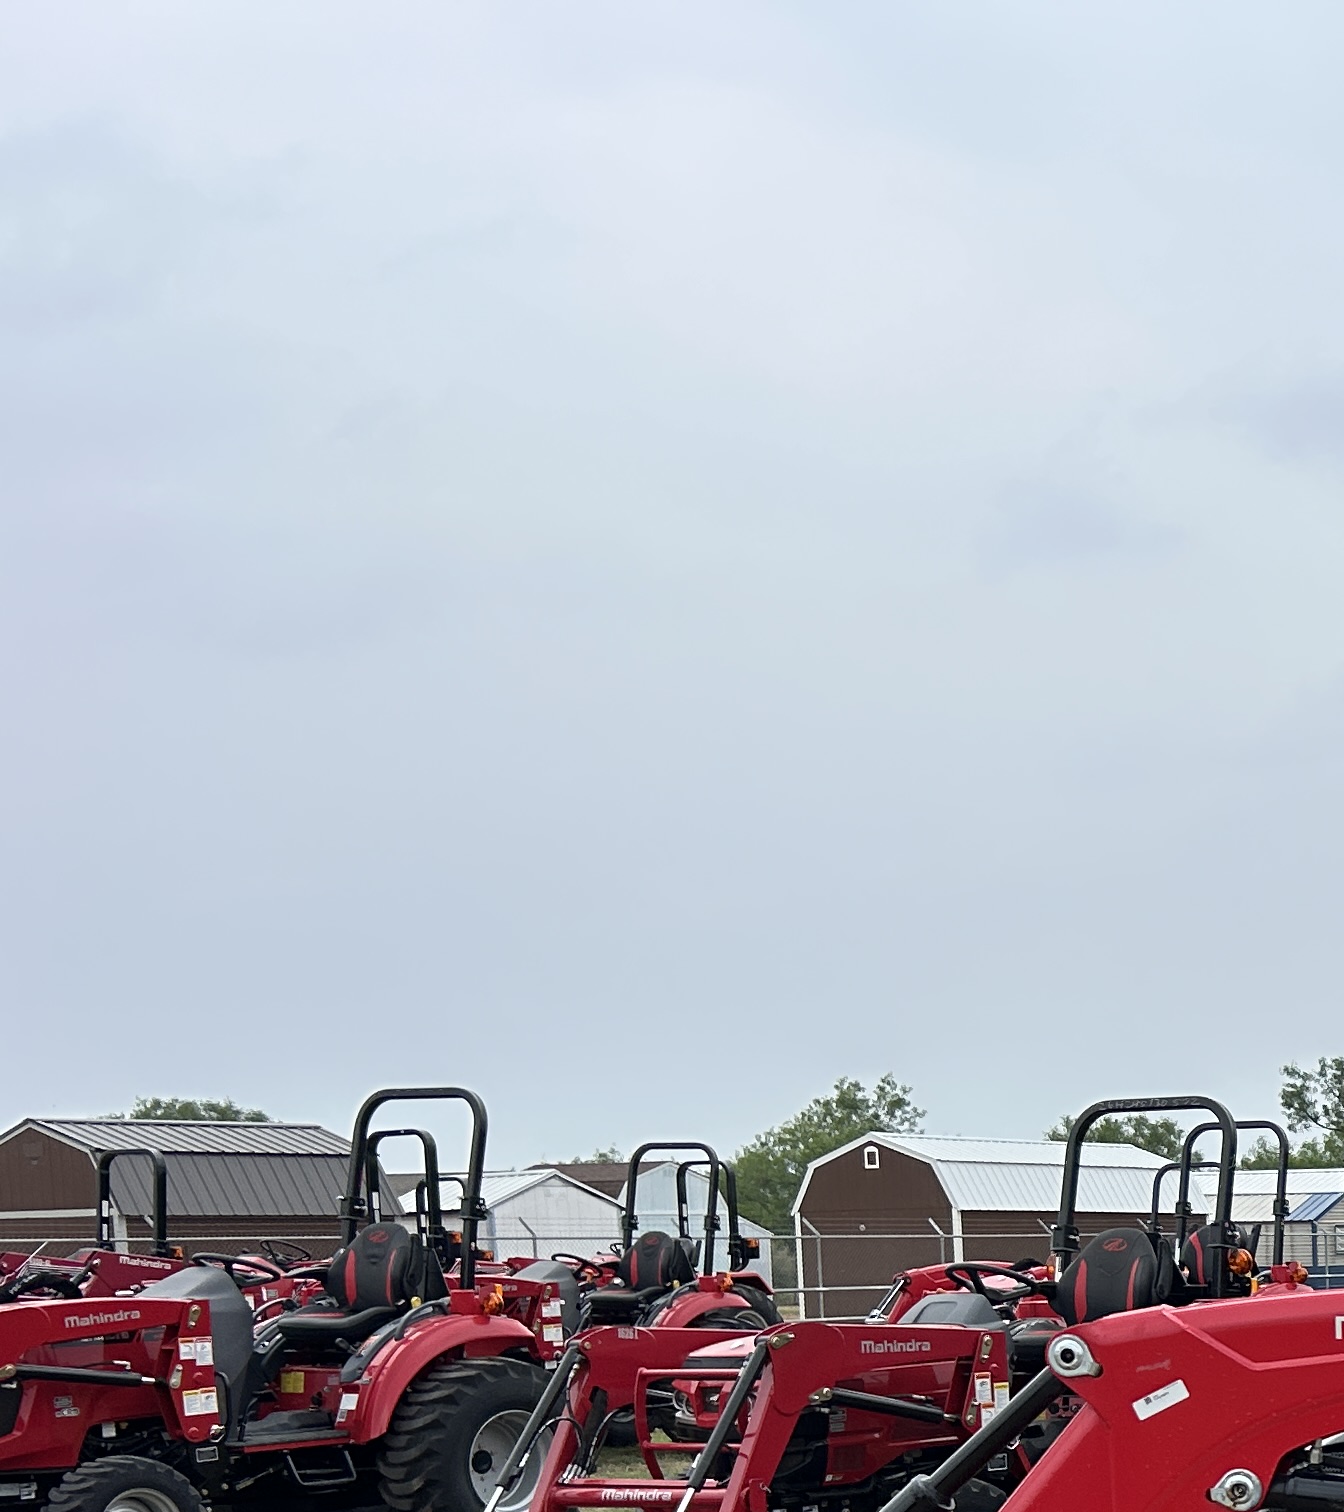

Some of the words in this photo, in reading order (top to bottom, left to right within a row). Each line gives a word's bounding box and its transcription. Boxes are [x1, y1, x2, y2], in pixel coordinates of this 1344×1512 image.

[119, 1255, 172, 1271] Mahindra
[64, 1310, 141, 1329] Mahindra
[860, 1338, 932, 1354] Mahindra
[601, 1488, 673, 1501] Mahindra
